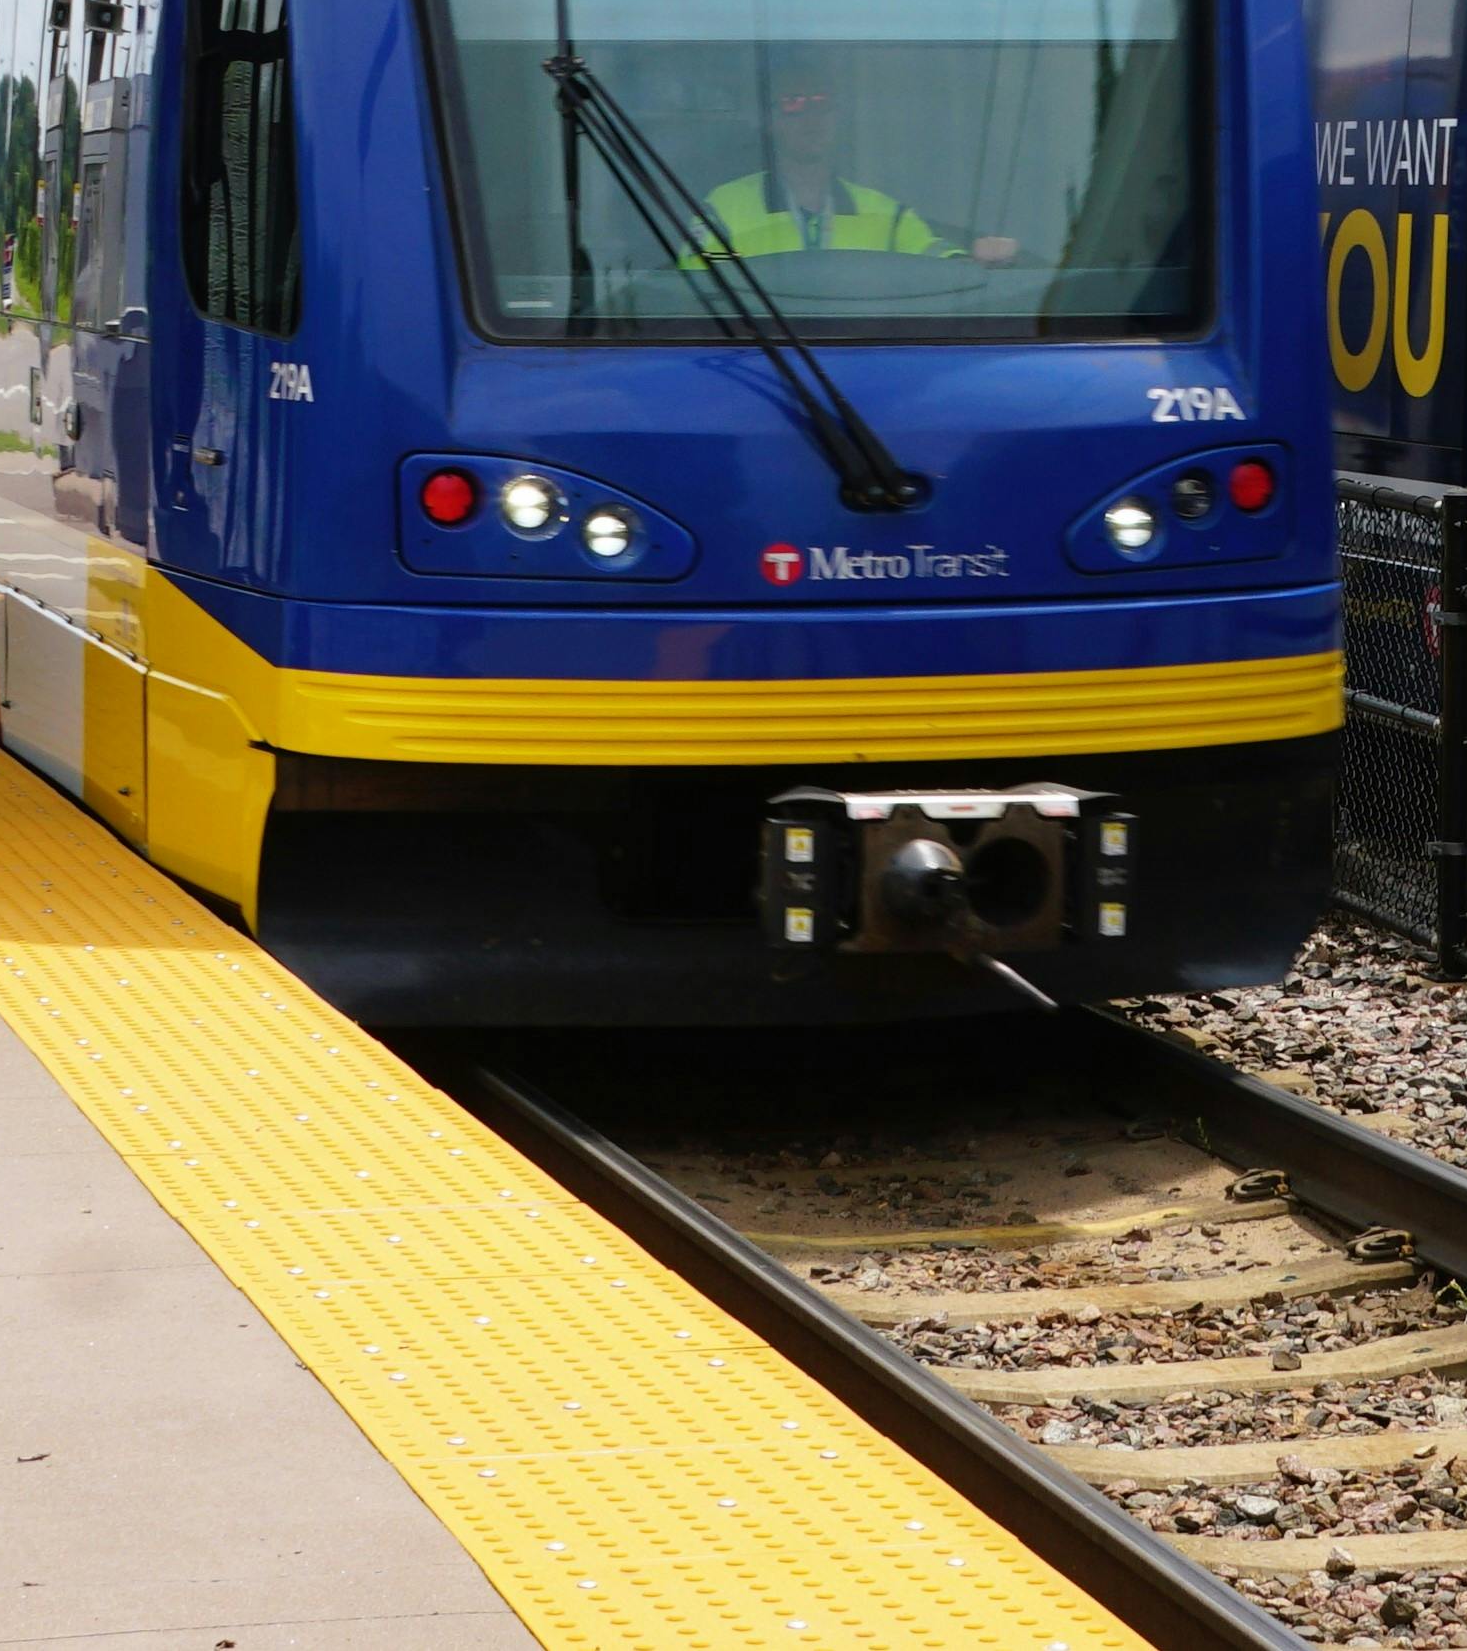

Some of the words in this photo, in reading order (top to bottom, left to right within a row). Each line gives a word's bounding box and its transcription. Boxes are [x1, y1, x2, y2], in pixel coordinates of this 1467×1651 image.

[1315, 120, 1358, 186] WE
[1366, 118, 1458, 186] WANT
[1318, 208, 1449, 398] OU
[270, 362, 314, 402] 219A
[1147, 387, 1247, 422] 219A
